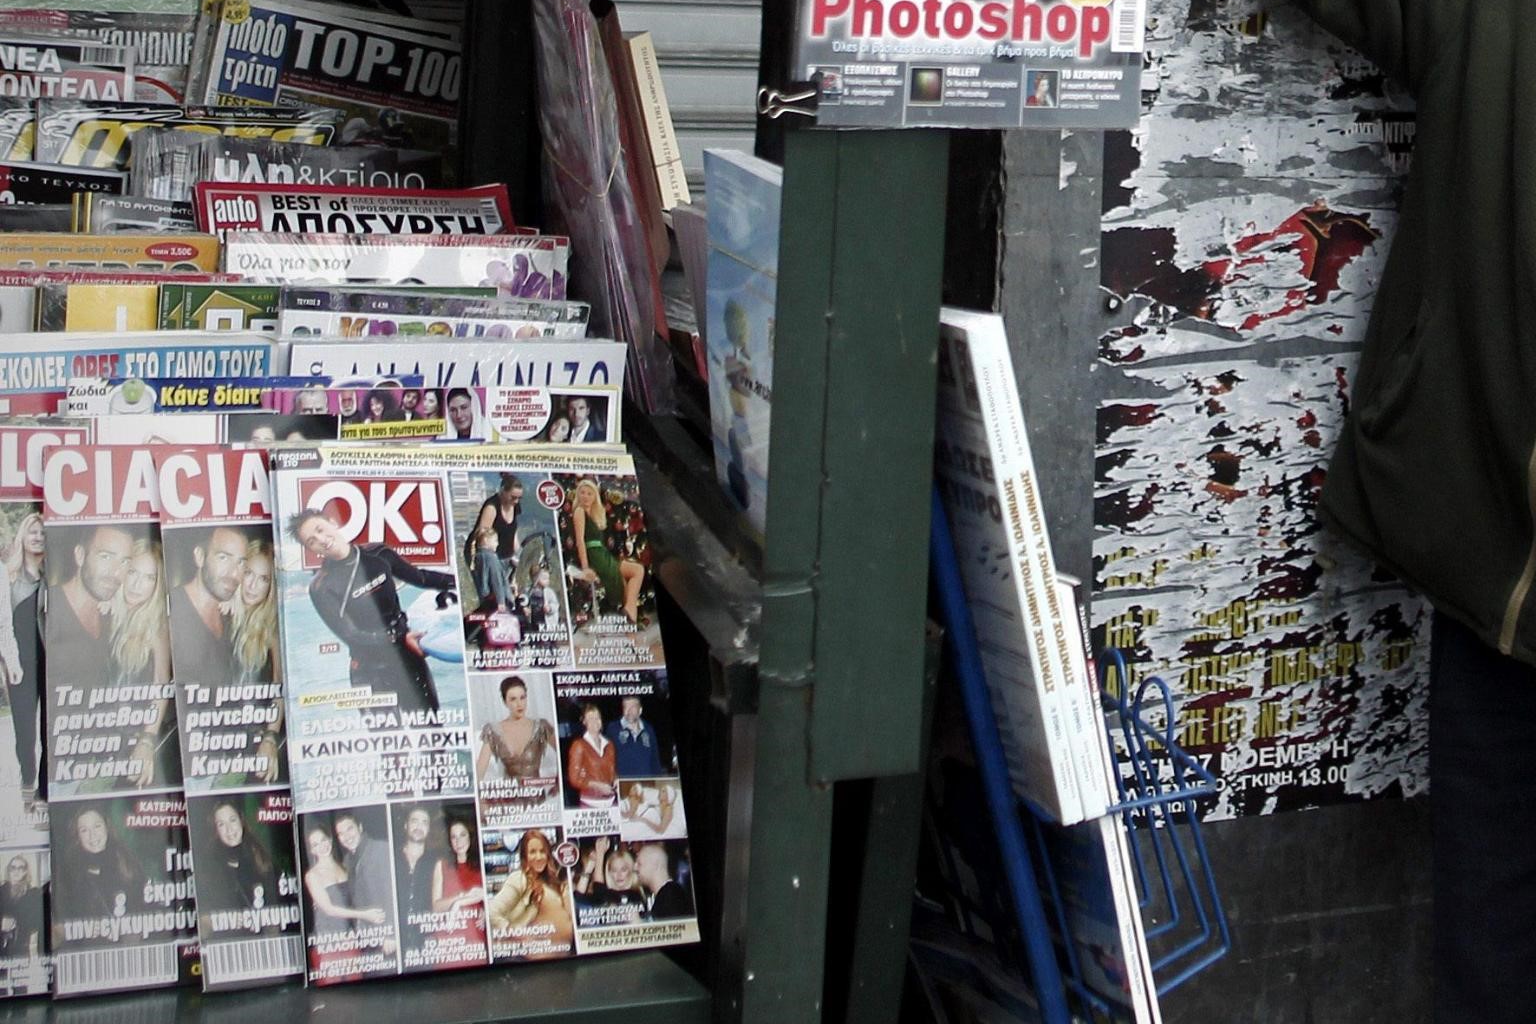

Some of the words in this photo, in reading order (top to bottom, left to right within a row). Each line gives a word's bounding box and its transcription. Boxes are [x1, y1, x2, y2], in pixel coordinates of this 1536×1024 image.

[229, 13, 288, 59] moto
[0, 46, 63, 73] ΝΕΑ
[293, 20, 462, 101] TOP-100
[996, 45, 1022, 58] βήμα
[1024, 47, 1047, 59] προς
[224, 53, 278, 93] τρίτη
[946, 66, 980, 77] GALLERY
[41, 177, 113, 192] ΤΕΥΧΟΣ
[118, 200, 132, 209] ΤΟ
[214, 194, 258, 223] auto
[271, 194, 322, 211] BEST
[329, 194, 350, 212] of
[351, 197, 376, 207] ΟΛΕΣ
[389, 198, 420, 208] ΤΙΜΕΣ
[352, 205, 411, 215] ΠΡΟΣΦΟΡΕΣ
[238, 252, 272, 270] Όλα
[71, 353, 120, 378] ΩΡΕΣ
[125, 351, 160, 378] ΣΤΟ
[165, 349, 217, 378] ΓΑΜΟ
[219, 348, 265, 378] ΤΟΥΣ
[68, 384, 108, 398] Ζώδια
[160, 384, 209, 407] Κάνε
[68, 401, 89, 412] και
[372, 427, 387, 437] τους
[389, 421, 444, 438] πρωταγωνιστές
[278, 452, 318, 461] ΠΡΟΣΩΠΑ
[482, 453, 515, 461] ΝΑΤΑΣΑ
[306, 480, 442, 545] OK!
[1003, 478, 1026, 544] ΙΩΑΝΝΙΔΗΣ
[1019, 469, 1043, 541] ΙΩΑΝΝΙΔΗΣ
[1019, 557, 1042, 627] ΔΗΜΗΤΡΙΟΣ
[1037, 554, 1060, 620] ΔΗΜΗΤΡΙΟΣ
[1033, 626, 1054, 694] ΣΤΡΑΤΗΓΟΣ
[1053, 620, 1075, 688] ΣΤΡΑΤΗΓΟΣ
[556, 675, 595, 685] ΣΚΟΡΔΑ
[600, 673, 641, 683] ΛΙΑΓΚΑΣ
[55, 684, 85, 707] Τα
[88, 682, 176, 708] μυστικά
[184, 684, 210, 704] Τα
[557, 687, 617, 698] ΚΥΡΙΑΚΑΤΙΚΗ
[618, 685, 654, 695] ΕΞΟΔΟΣ
[52, 704, 158, 737] ραντεβού
[185, 702, 280, 733] ραντεβού
[302, 713, 399, 736] ΕΛΕΟΝΩΡΑ
[401, 709, 466, 728] ΜΕΛΕΤΗ
[54, 734, 121, 756] Βίσση
[188, 731, 247, 753] Βίσση
[301, 733, 414, 760] ΚΑΙΝΟΥΡΙΑ
[417, 730, 469, 750] ΑΡΧΗ
[55, 757, 143, 781] Κανάκη
[191, 754, 269, 777] Κανάκη
[433, 752, 459, 766] ΣΤΗ
[419, 763, 468, 779] ΑΠΟΧΗ
[440, 776, 470, 791] ΖΩΗ
[479, 779, 519, 790] ΕΥΓΕΝΙΑ
[479, 788, 544, 800] ΜΑΝΩΛΙΔΟΥ
[407, 909, 479, 925] ΠΑΠΟΥΤΣΑΚΗ
[307, 925, 395, 946] ΠΑΠΑΚΑΛΙΑΤΗΣ
[317, 937, 386, 953] ΚΑΛΟΓΗΡΟΥ
